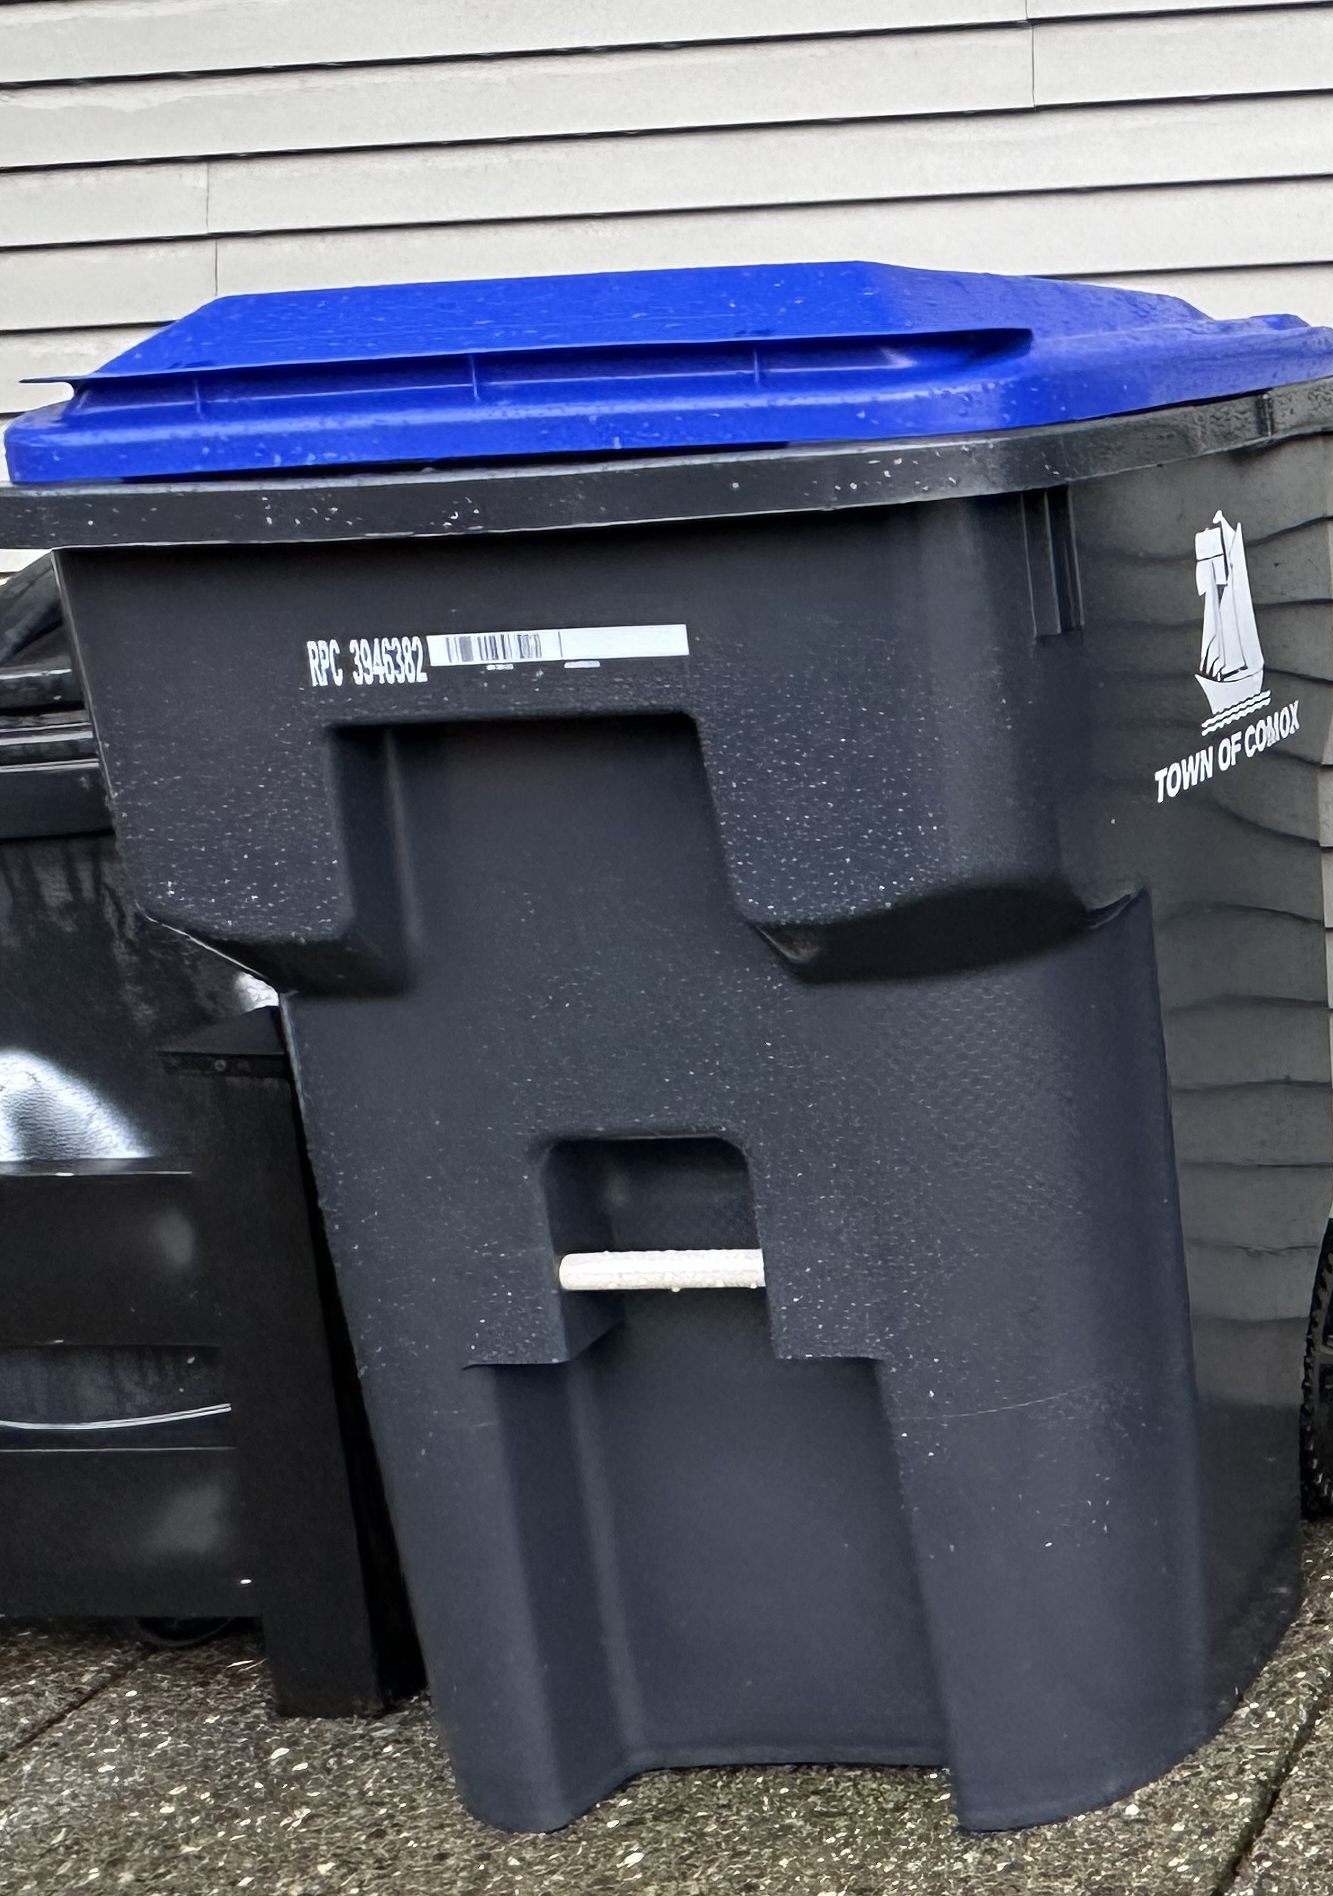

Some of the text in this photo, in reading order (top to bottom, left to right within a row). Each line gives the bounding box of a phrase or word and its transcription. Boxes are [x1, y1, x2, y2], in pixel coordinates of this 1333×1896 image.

[306, 635, 429, 687] RPC 3946382
[1154, 699, 1300, 804] TOWN OF COMOX
